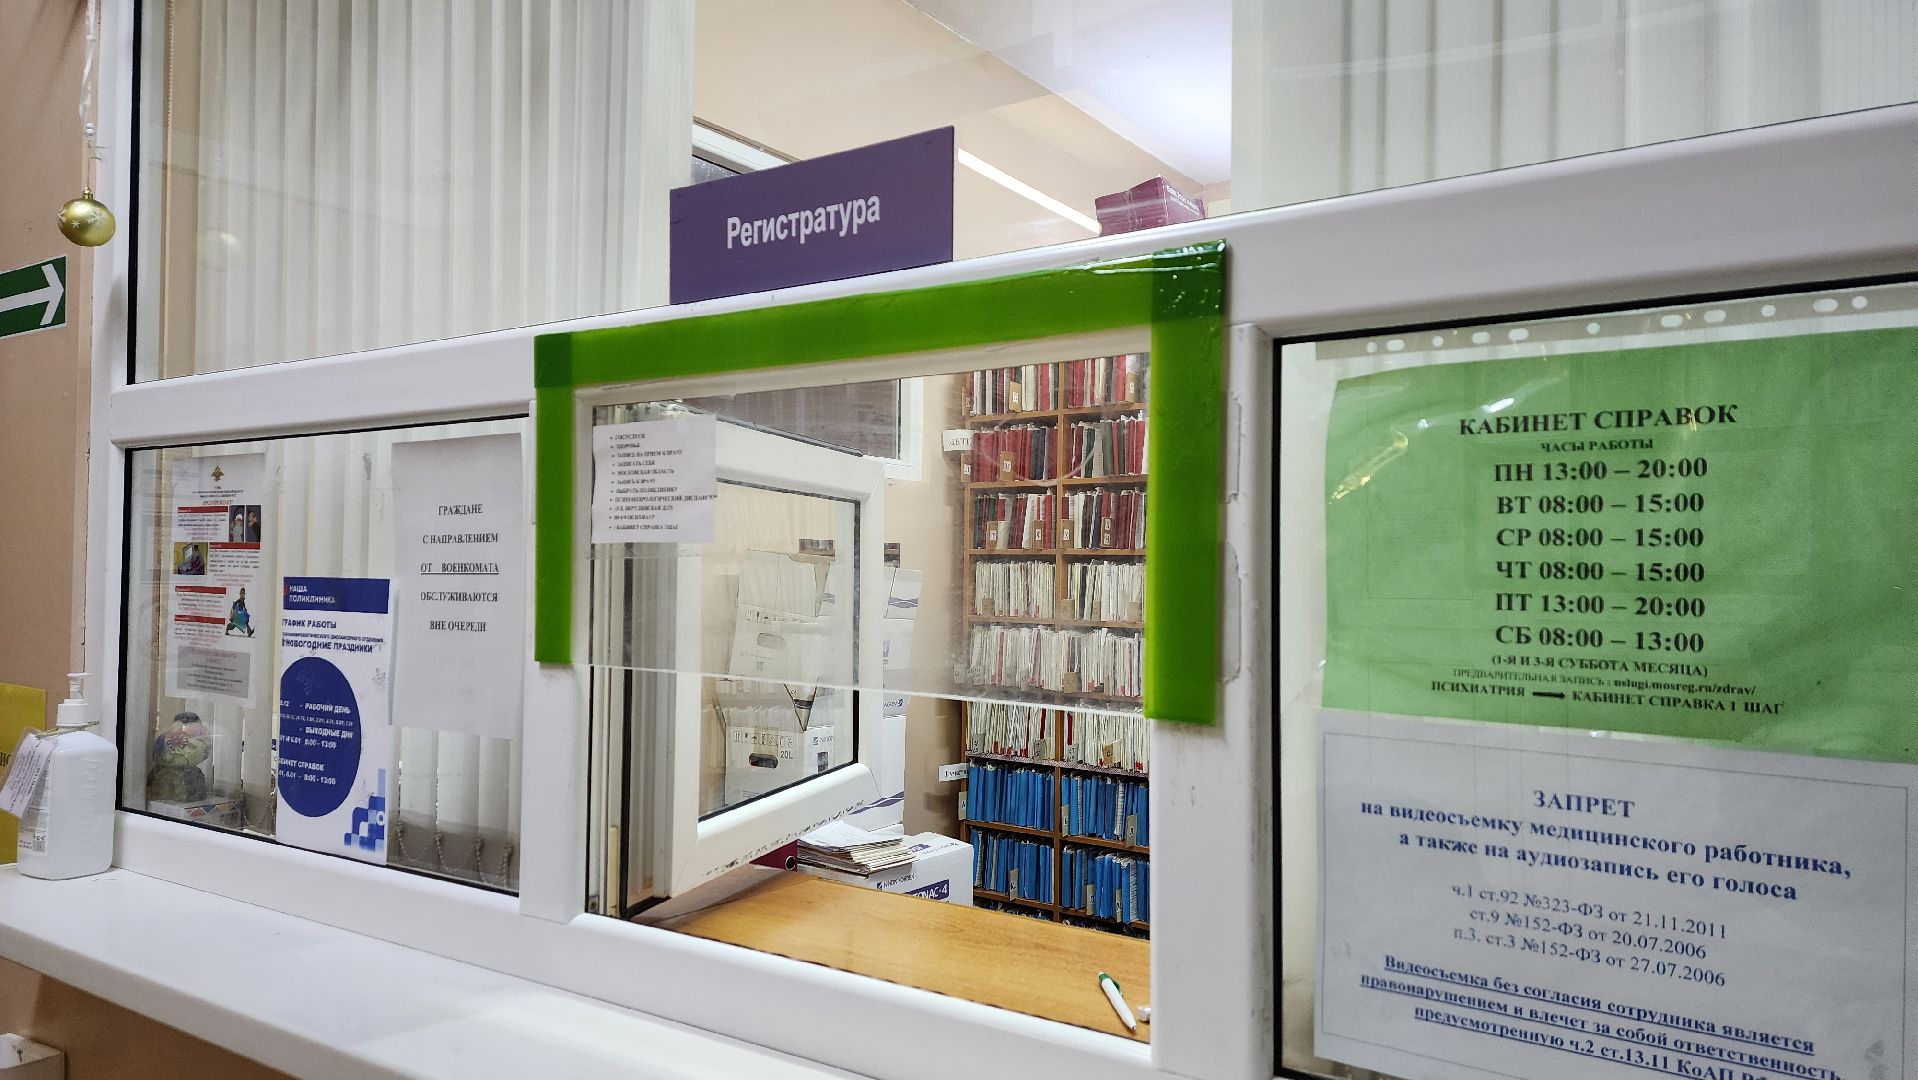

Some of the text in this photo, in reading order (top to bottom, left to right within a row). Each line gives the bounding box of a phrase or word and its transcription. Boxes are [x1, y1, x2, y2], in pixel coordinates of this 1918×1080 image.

[727, 195, 881, 249] Регистратура
[1459, 404, 1739, 435] КАБИНЕТ СПРАВОК
[1541, 438, 1654, 453] ЧАСЫ РАБОТЫ
[1494, 463, 1534, 482] ПН
[1543, 460, 1608, 481] 13:00
[1637, 457, 1708, 478] 20:00
[438, 504, 483, 516] ГРАЖДАНЕ
[1497, 495, 1532, 514] ВТ
[1538, 494, 1604, 513] 08:00
[1636, 492, 1705, 513] 15:00
[422, 533, 498, 544] С НАПРАВЛЕНИЕМ
[1496, 528, 1532, 547] СР
[1538, 527, 1604, 547] 08:00
[1635, 527, 1705, 547] 15:00
[420, 562, 499, 573] ОТ ВОЕНКОМАТА
[1495, 560, 1533, 579] ЧТ
[1539, 561, 1604, 581] 08:00
[1636, 562, 1705, 583] 15:00
[420, 591, 498, 602] ОБСЛУЖИВАЮТСЯ
[1495, 593, 1533, 611] ПТ
[1541, 594, 1605, 614] 13:00
[1635, 596, 1706, 617] 20:00
[307, 620, 337, 629] РАБОТЫ
[429, 620, 487, 632] ВНЕ ОЧЕРЕДИ
[334, 642, 373, 653] ПРАЗДНИКИ
[1495, 625, 1532, 645] СБ
[1539, 627, 1604, 647] 08:00
[1635, 631, 1705, 654] 13:00
[1492, 655, 1708, 678] (1-Я И 3-Я СУББОТА МЕСЯЦА)
[1453, 668, 1557, 683] ПРЕДВАРИТЕЛЬНАЯ
[1561, 676, 1606, 687] ЗАПИСЬ
[1614, 678, 1757, 696] uslugi.mosreg.ru/zdrav/
[1431, 680, 1526, 697] ПСИХИАТРИЯ
[1572, 690, 1645, 705] КАБИНЕТ
[1648, 695, 1726, 712] СПРАВКА
[305, 703, 333, 713] РАБОЧИЙ
[334, 706, 351, 714] ДЕНЬ
[305, 727, 353, 739] ВЫХОДНЫЕ ДНИ
[298, 761, 325, 771] СПРАВОК
[780, 751, 793, 760] 20L
[1533, 790, 1636, 818] ЗАПРЕТ
[1361, 801, 1851, 879] на видеосъемку медицинского работника,
[1400, 833, 1798, 900] а также на аудиозапись его голоса
[1479, 889, 1519, 905] ст.92
[1523, 893, 1604, 919] №323-ФЗ
[1608, 911, 1628, 924] от
[1633, 910, 1727, 939] 21.11.2011
[1470, 910, 1707, 960] ст.9 №152-ФЗ от 20.07.2006
[1486, 933, 1516, 948] ст.3
[1520, 937, 1601, 964] №152-ФЗ
[1606, 954, 1626, 968] от
[1630, 956, 1726, 987] 27.07.2006
[1360, 975, 1508, 1013] правонарушением
[1514, 1006, 1523, 1017] и
[1529, 1009, 1588, 1030] влечет
[1593, 1021, 1611, 1035] за
[1616, 1027, 1668, 1047] собой
[1384, 955, 1815, 1054] Видеосъемка без согласия сотрудника является
[1414, 1006, 1565, 1047] предусмотренную
[1569, 1040, 1595, 1055] ч.2
[1600, 1046, 1669, 1070] ст.13.11
